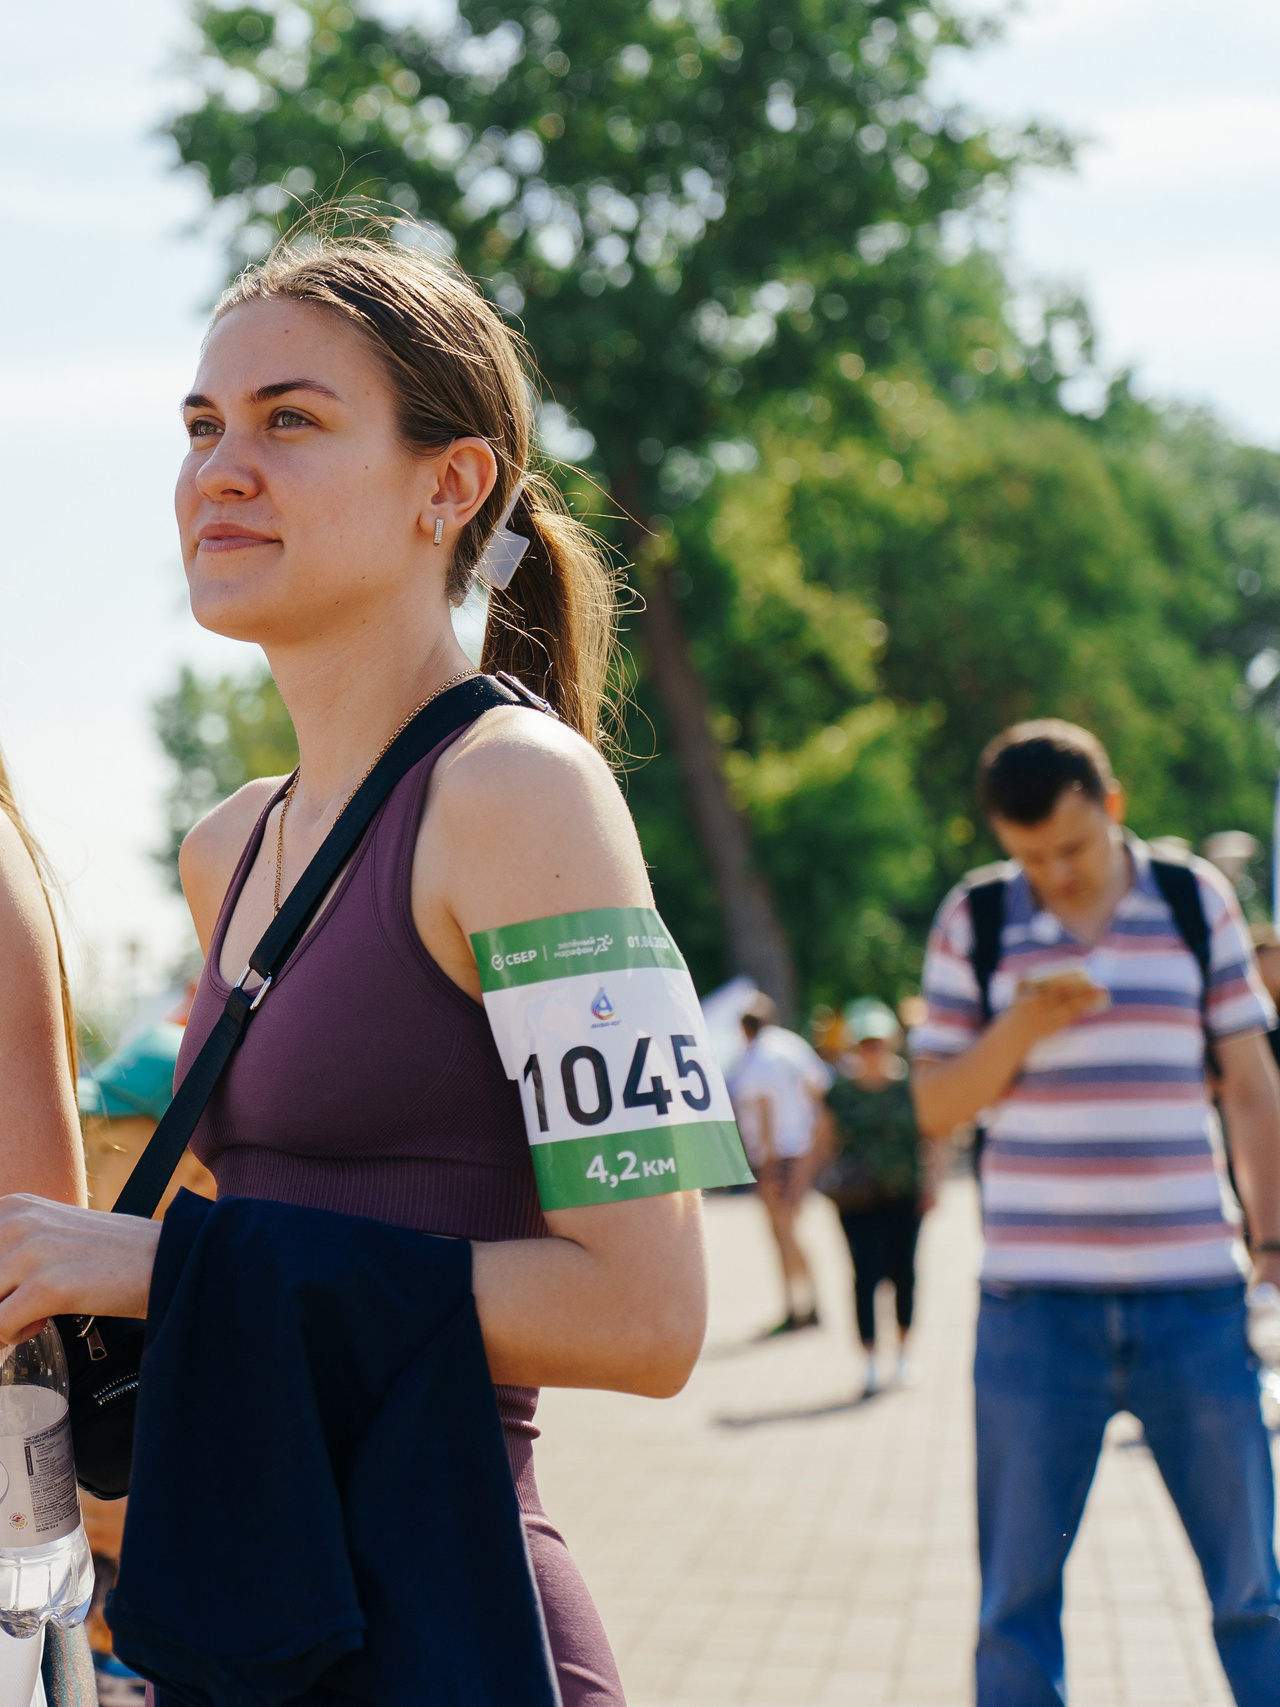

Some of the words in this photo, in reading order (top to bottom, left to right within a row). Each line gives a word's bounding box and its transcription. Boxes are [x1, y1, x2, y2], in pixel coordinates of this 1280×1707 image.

[505, 950, 537, 966] СБЕР
[553, 946, 594, 958] марафон
[523, 1034, 711, 1133] 1045
[585, 1150, 640, 1188] 4,2
